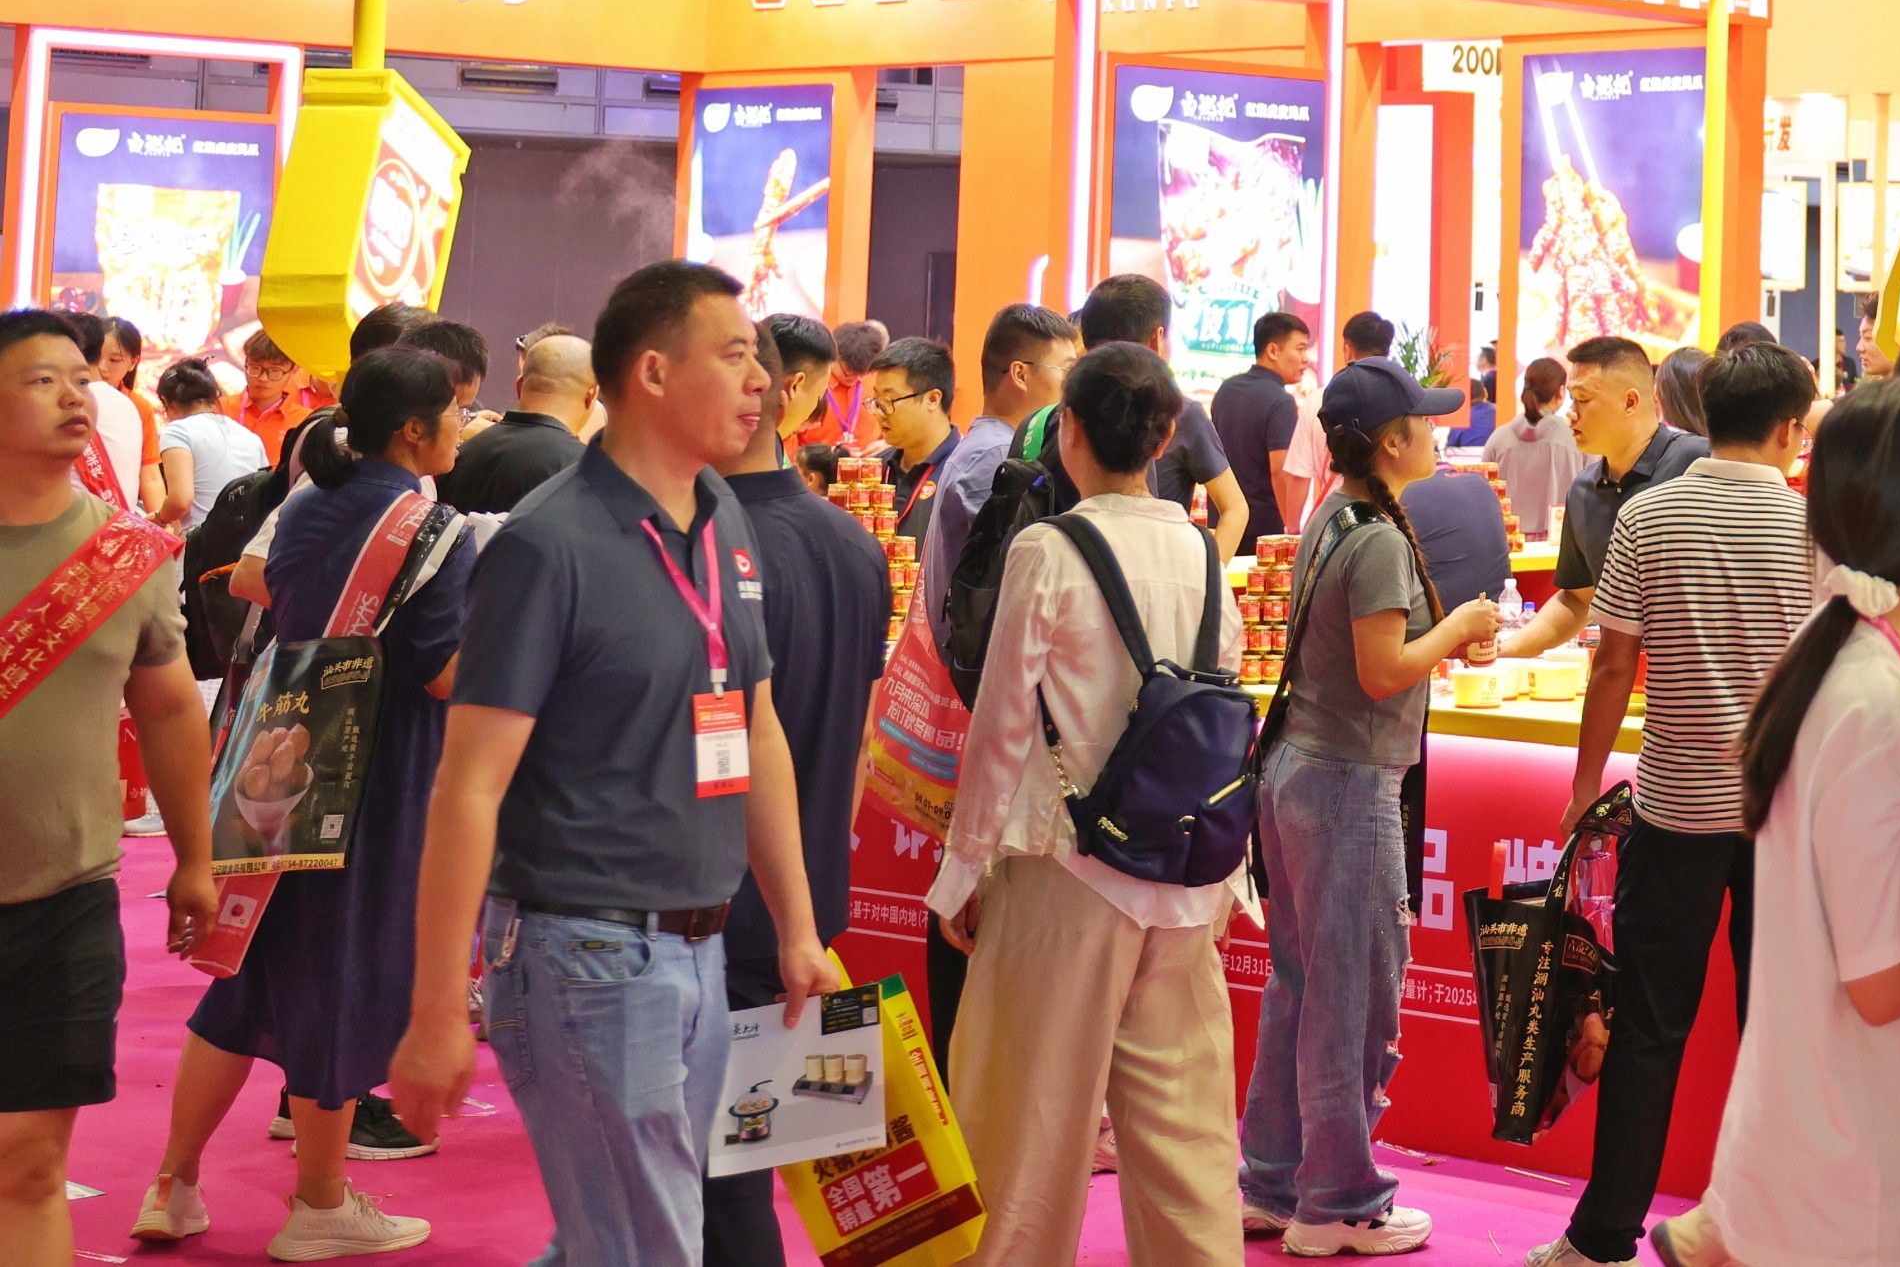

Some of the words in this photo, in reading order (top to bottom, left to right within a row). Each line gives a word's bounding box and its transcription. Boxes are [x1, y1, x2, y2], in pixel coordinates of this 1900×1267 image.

[1453, 44, 1503, 75] 200
[255, 690, 311, 724] 牛筋丸
[1510, 939, 1555, 1117] 专注潮汕丸类生产服务商
[813, 1114, 916, 1184] 火锅酱
[826, 1174, 866, 1210] 全国
[862, 1161, 928, 1212] 第一
[836, 1199, 877, 1233] 销量
